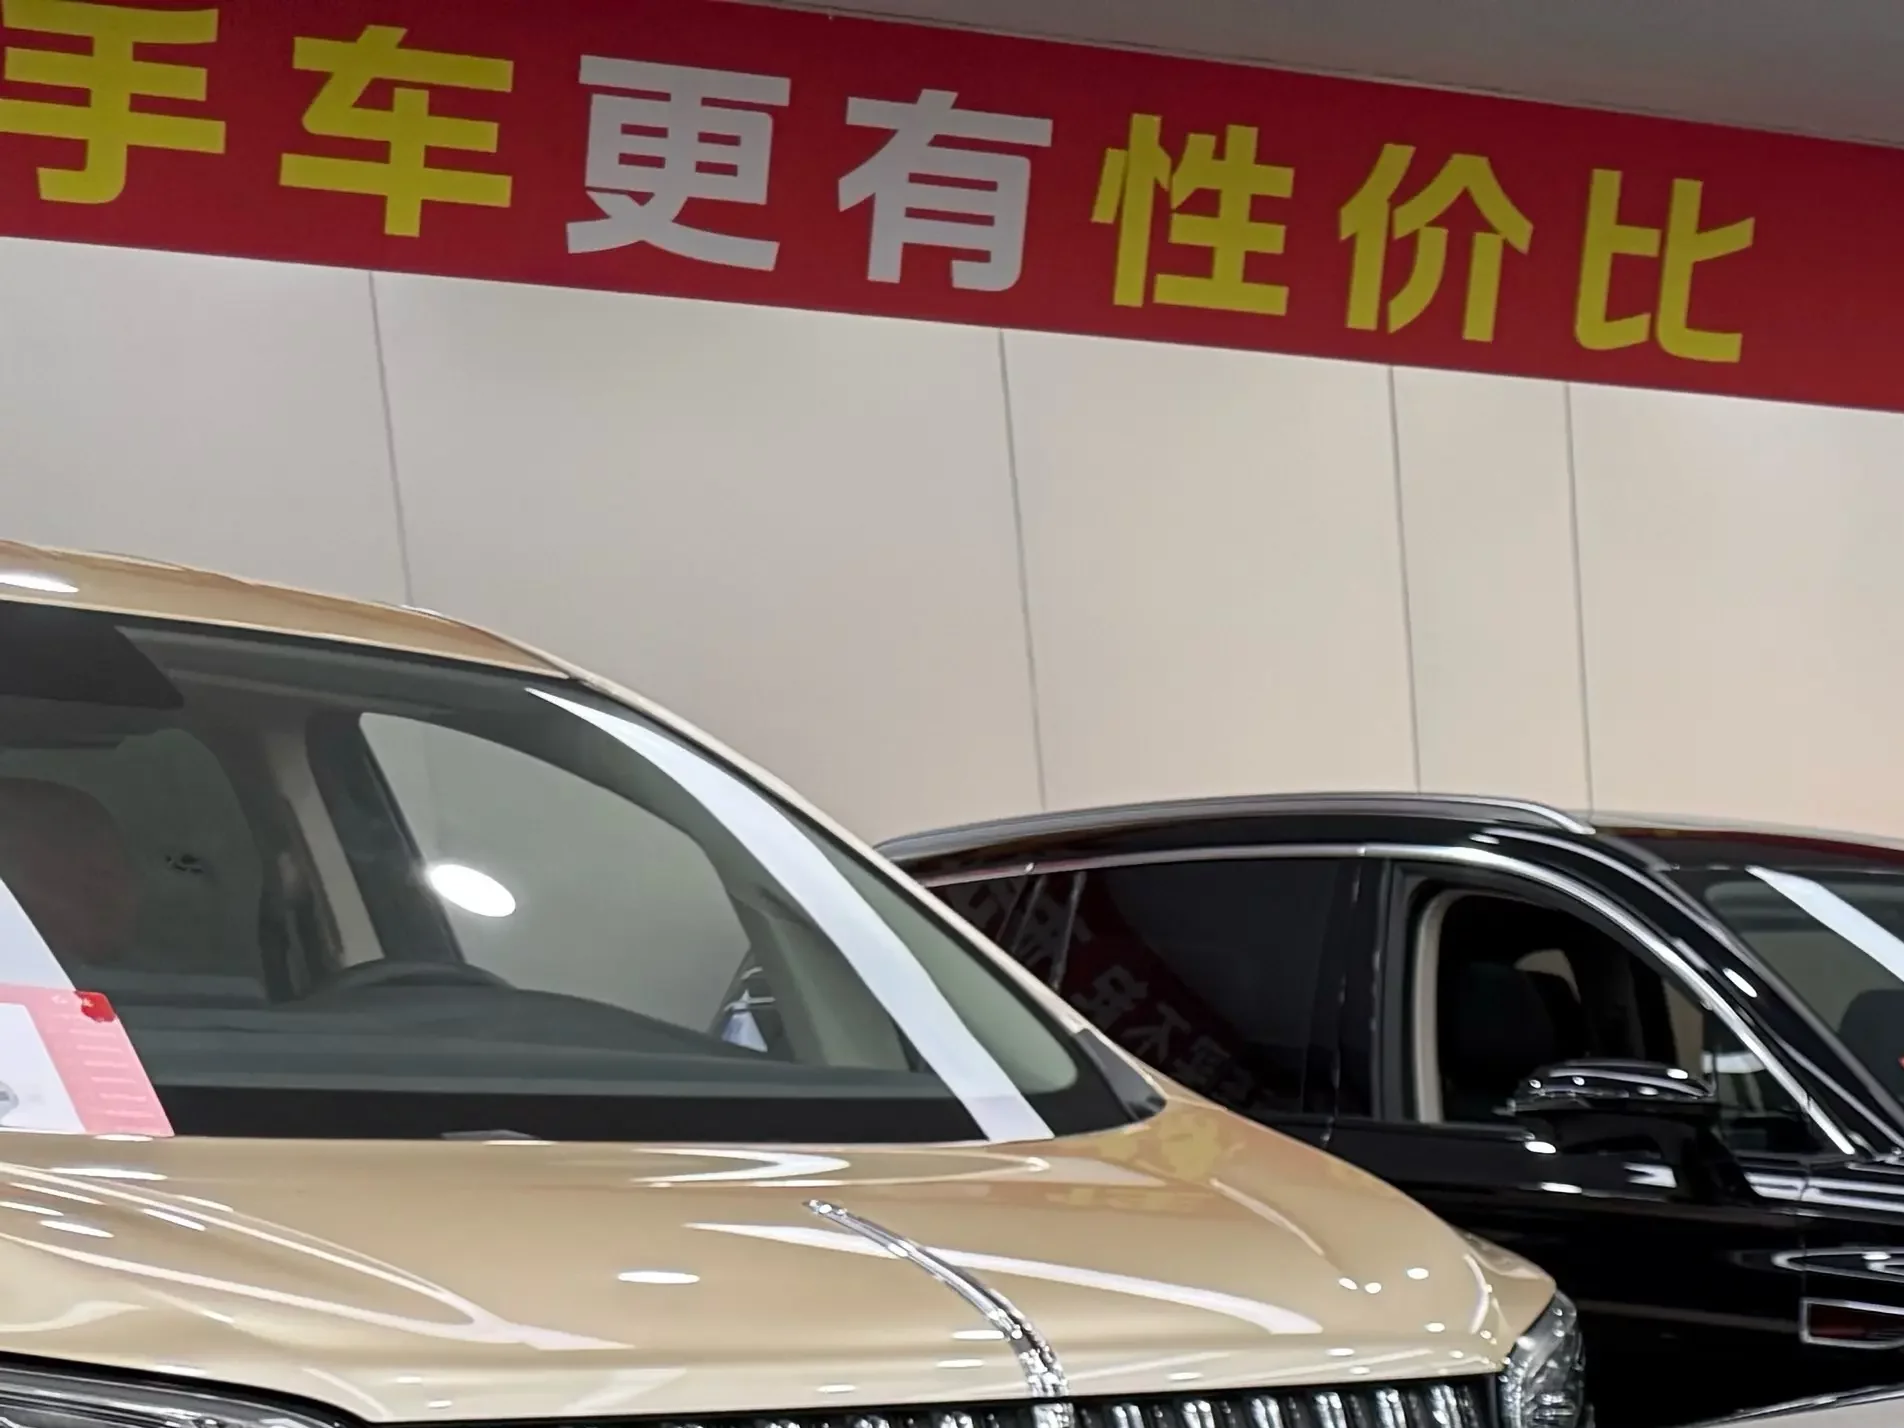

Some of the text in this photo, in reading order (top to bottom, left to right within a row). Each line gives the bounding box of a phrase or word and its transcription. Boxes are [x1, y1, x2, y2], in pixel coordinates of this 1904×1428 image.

[0, 0, 1756, 365] 手车更有性价比
